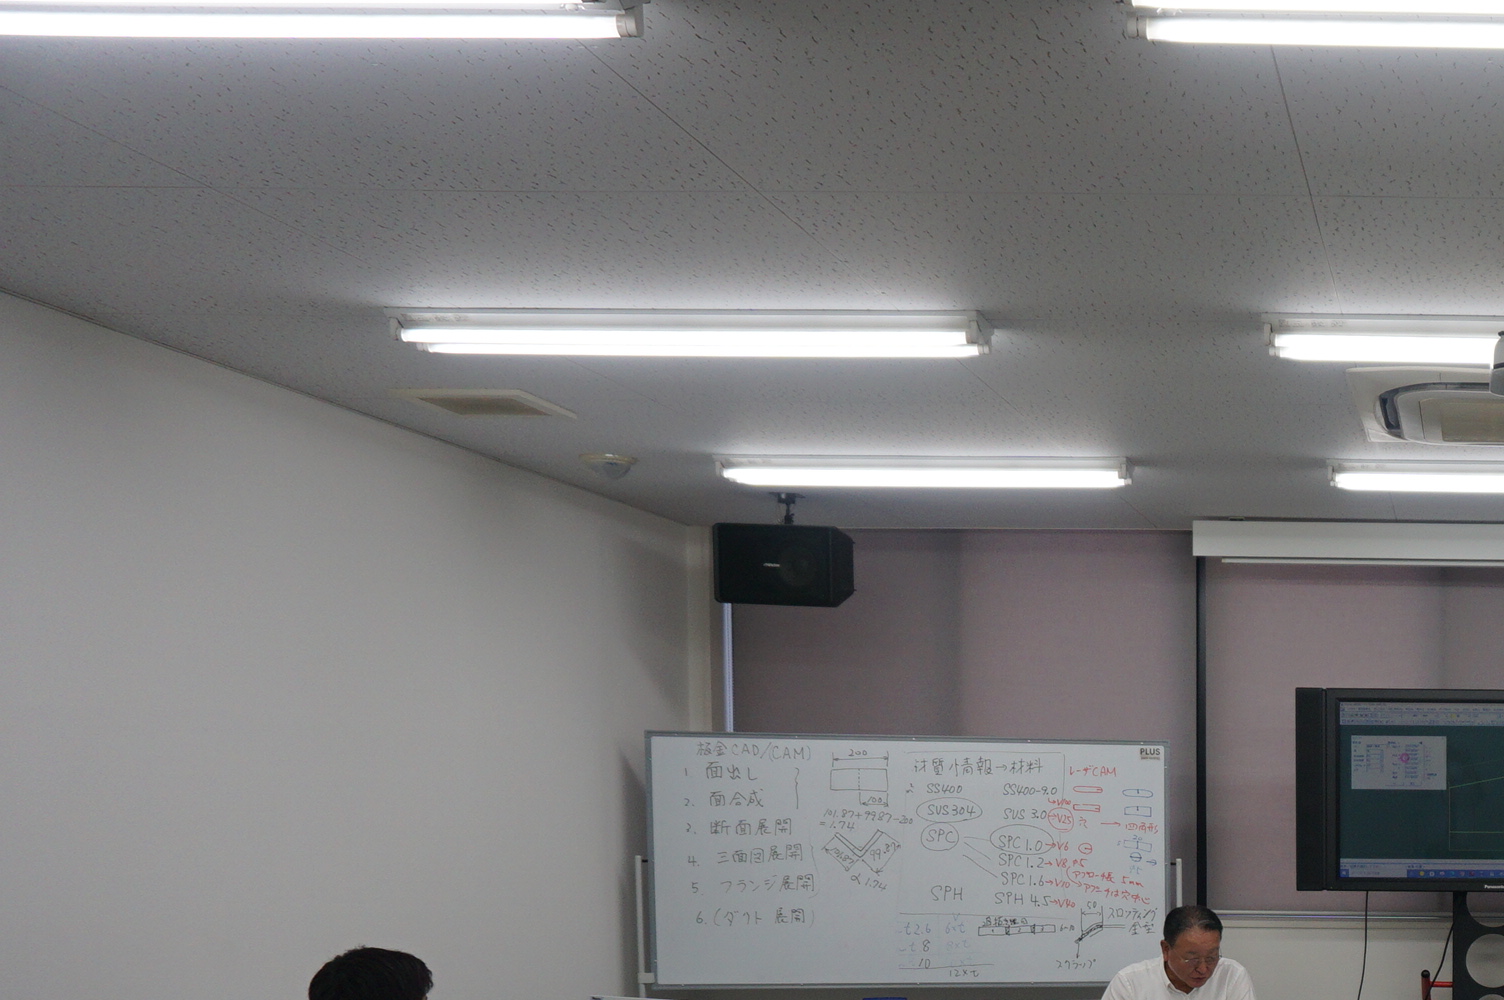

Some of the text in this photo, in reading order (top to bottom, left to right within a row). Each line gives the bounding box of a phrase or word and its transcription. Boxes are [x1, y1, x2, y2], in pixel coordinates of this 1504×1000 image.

[849, 749, 868, 757] 200
[1139, 747, 1161, 756] PLUS
[705, 761, 758, 781] 面出し
[926, 782, 963, 794] SS400
[709, 790, 764, 807] 面合成
[925, 828, 956, 844] SPC
[998, 834, 1021, 849] SPC
[998, 852, 1022, 867] SPC
[1000, 871, 1025, 886] SPC
[930, 885, 964, 901] SPH
